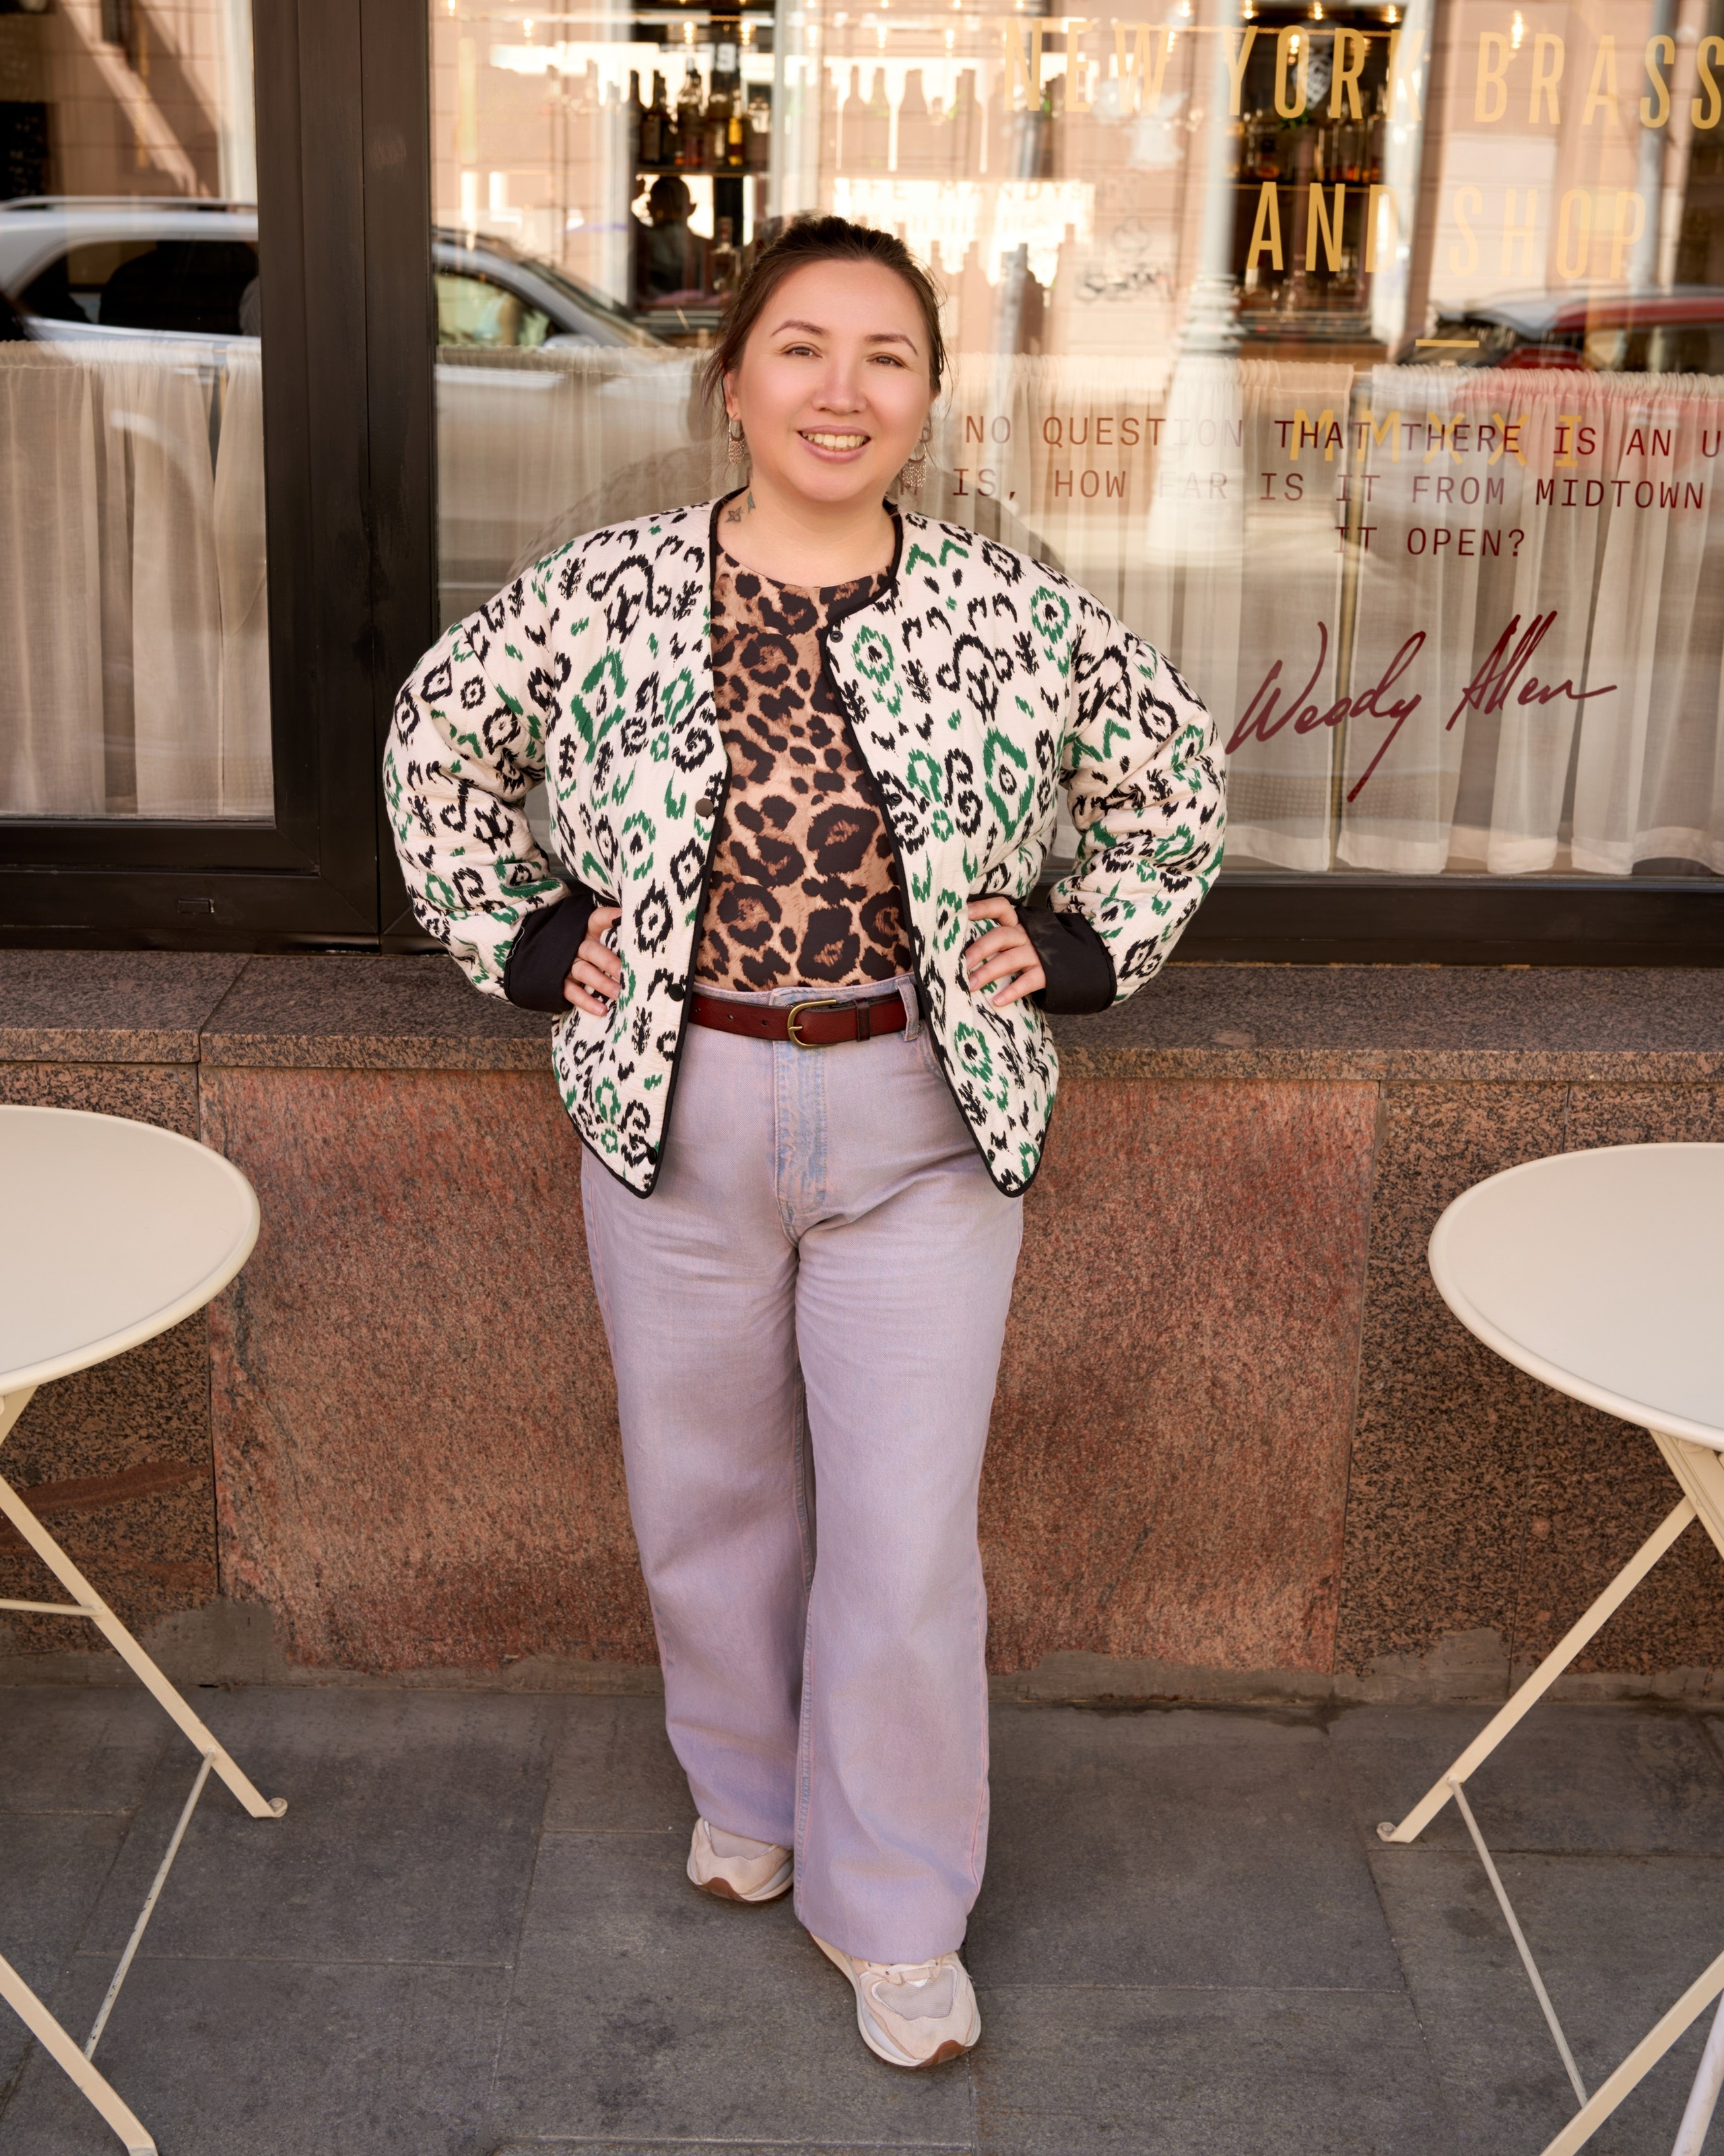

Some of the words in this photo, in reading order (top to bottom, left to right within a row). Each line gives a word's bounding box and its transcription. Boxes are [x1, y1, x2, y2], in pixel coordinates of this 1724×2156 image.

[1004, 20, 1172, 113] NEW
[1223, 25, 1426, 121] YORK
[1474, 31, 1724, 129] BRASS
[1246, 181, 1399, 272] AND
[1449, 186, 1646, 279] SHOP
[966, 416, 1011, 444] NO
[1042, 416, 1242, 448] QUESTION
[1274, 420, 1371, 449] THAT
[1401, 423, 1521, 453] THERE
[1553, 426, 1596, 455] IS
[1626, 428, 1671, 457] AN
[952, 468, 1016, 500] IS,
[1055, 470, 1126, 498] HOW
[1158, 471, 1228, 499] FAR
[1260, 473, 1303, 500] IS
[1336, 474, 1381, 502] IT
[1412, 476, 1504, 504] FROM
[1535, 478, 1704, 509] MIDTOWN
[1334, 527, 1377, 553] IT
[1407, 527, 1525, 556] OPEN?
[1225, 620, 1426, 802] Woody
[1445, 610, 1618, 731] Allen
